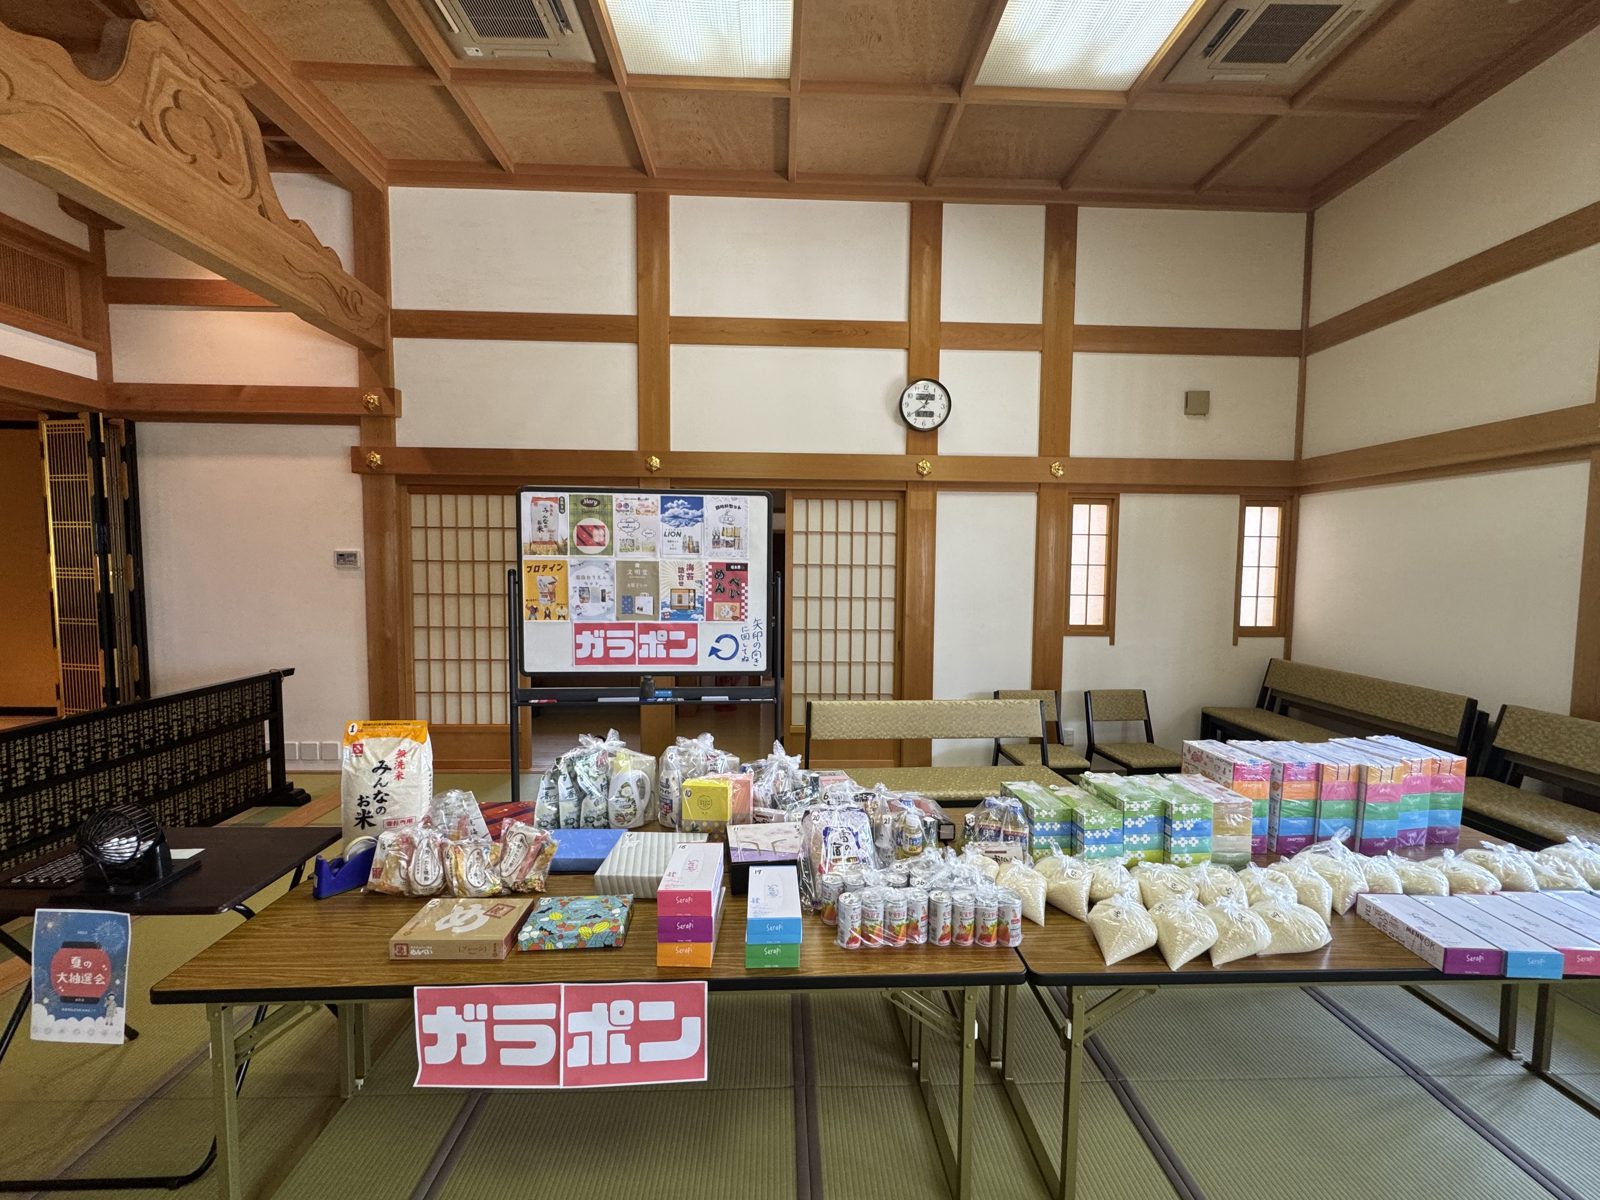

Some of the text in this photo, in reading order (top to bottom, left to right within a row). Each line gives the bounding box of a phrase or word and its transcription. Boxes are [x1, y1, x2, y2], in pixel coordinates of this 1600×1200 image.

[582, 498, 598, 507] Mary
[526, 563, 564, 574] プロテイン
[686, 564, 694, 580] 海苔
[714, 569, 725, 594] めん
[729, 578, 741, 599] べい
[576, 629, 696, 659] ガラポン
[751, 617, 763, 667] 矢印の向き
[394, 749, 407, 781] 無洗米
[372, 760, 392, 815] みんなの
[354, 794, 376, 830] お米
[435, 904, 489, 933] め
[70, 956, 92, 969] 夏の
[56, 972, 105, 985] 大抽選会
[422, 1000, 702, 1068] ガラポン
